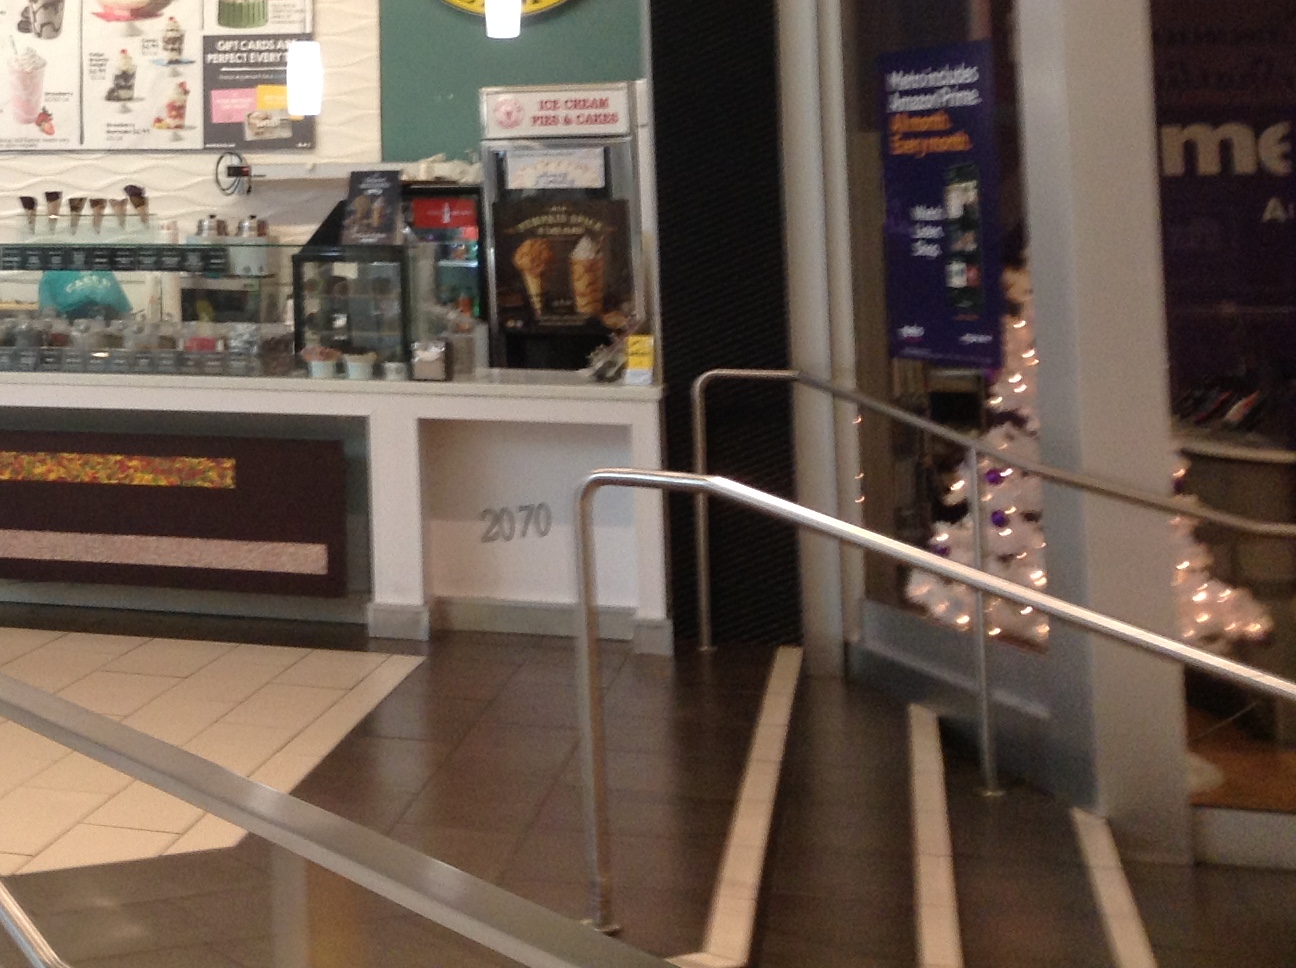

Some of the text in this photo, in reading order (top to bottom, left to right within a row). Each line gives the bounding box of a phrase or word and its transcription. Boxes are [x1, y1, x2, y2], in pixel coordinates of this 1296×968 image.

[217, 40, 239, 52] GIFT
[240, 39, 275, 51] CARDS
[206, 52, 247, 64] PERFECT
[249, 52, 284, 63] EVERY
[538, 97, 609, 111] ICE CREAM
[576, 112, 619, 125] CAKES
[480, 501, 553, 544] 2070
